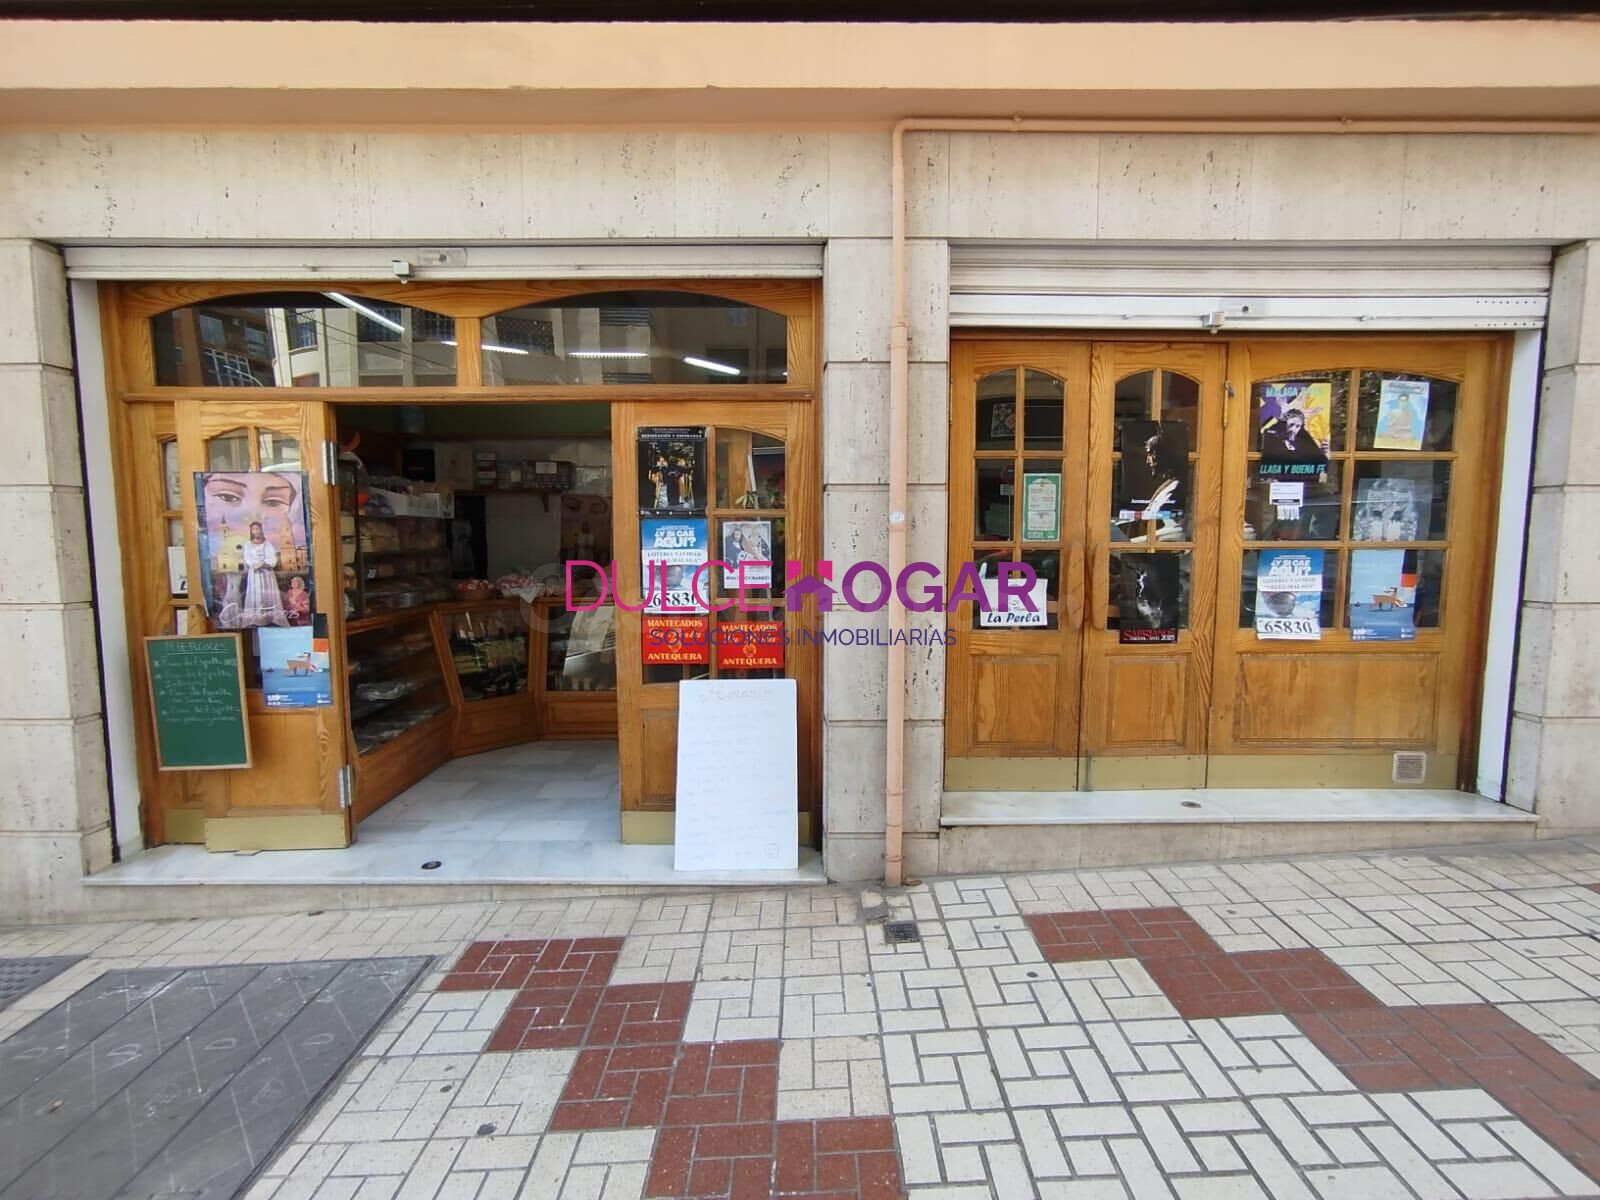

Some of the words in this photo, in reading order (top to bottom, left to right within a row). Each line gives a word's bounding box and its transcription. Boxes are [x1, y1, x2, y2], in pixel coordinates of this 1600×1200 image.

[1260, 464, 1282, 474] LLAGA
[1284, 464, 1291, 474] Y
[1290, 464, 1315, 474] BUENA
[987, 613, 1001, 623] La
[1007, 612, 1040, 623] Perla
[647, 619, 703, 627] MANTECADOS
[1264, 620, 1312, 633] 65830
[722, 624, 777, 632] MANTECADOS
[648, 653, 703, 661] ANTEQUERA
[723, 657, 777, 666] ANTEQUERA
